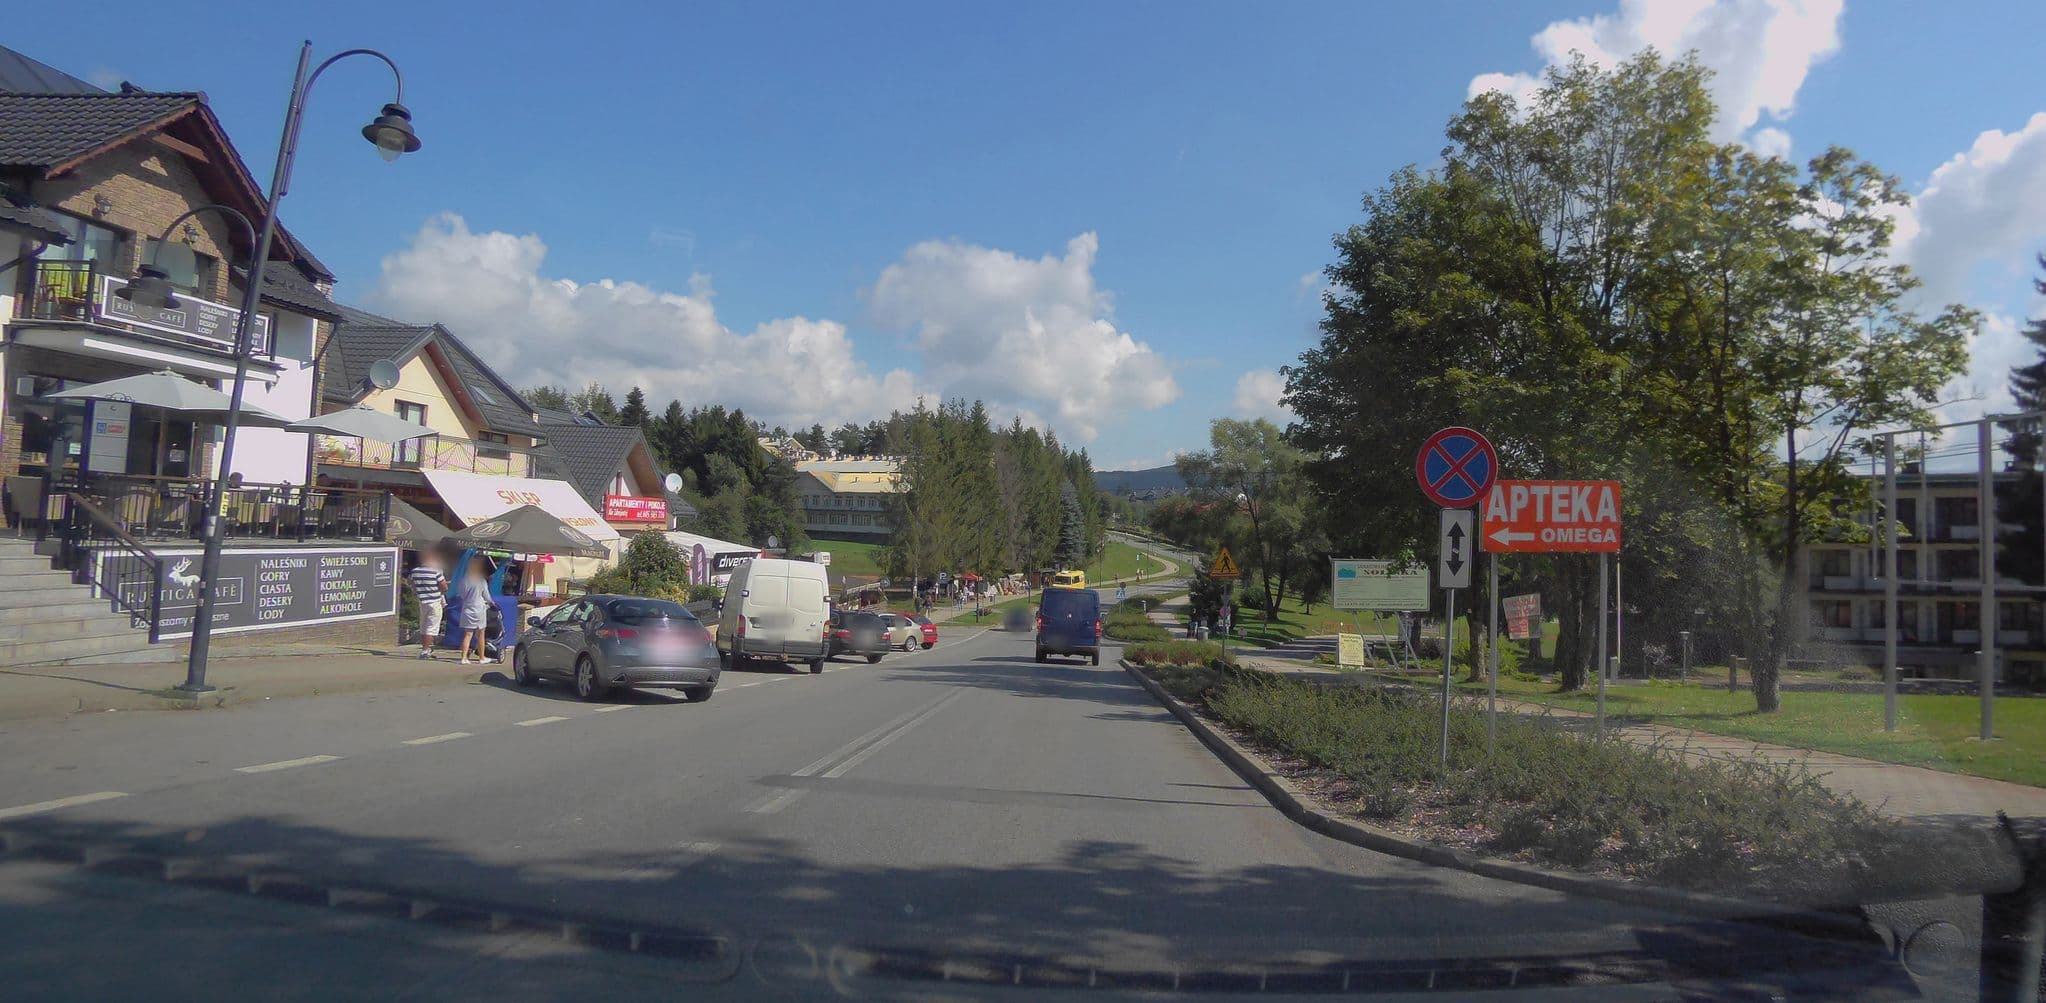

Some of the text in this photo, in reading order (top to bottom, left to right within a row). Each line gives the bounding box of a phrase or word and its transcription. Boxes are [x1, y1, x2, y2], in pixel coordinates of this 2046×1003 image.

[197, 327, 213, 336] LODY
[496, 489, 542, 506] SKLEP
[609, 498, 645, 509] APARTAMENTY
[648, 501, 666, 510] POKOJE
[1485, 485, 1618, 523] APTEKA
[1540, 527, 1617, 543] OMEGA
[260, 557, 307, 569] NALEŚNIKI
[320, 555, 368, 567] ŚWIEŻE SOKI
[260, 571, 290, 582] GOFRY
[320, 569, 344, 579] KAWY
[940, 572, 947, 580] P
[259, 583, 292, 595] CIASTA
[320, 579, 358, 591] KOKTAJLE
[127, 588, 195, 603] RUTICA
[320, 590, 367, 603] LEMONIADY
[259, 596, 293, 608] DESERY
[258, 609, 285, 620] LODY
[320, 602, 362, 615] ALKOHOLE
